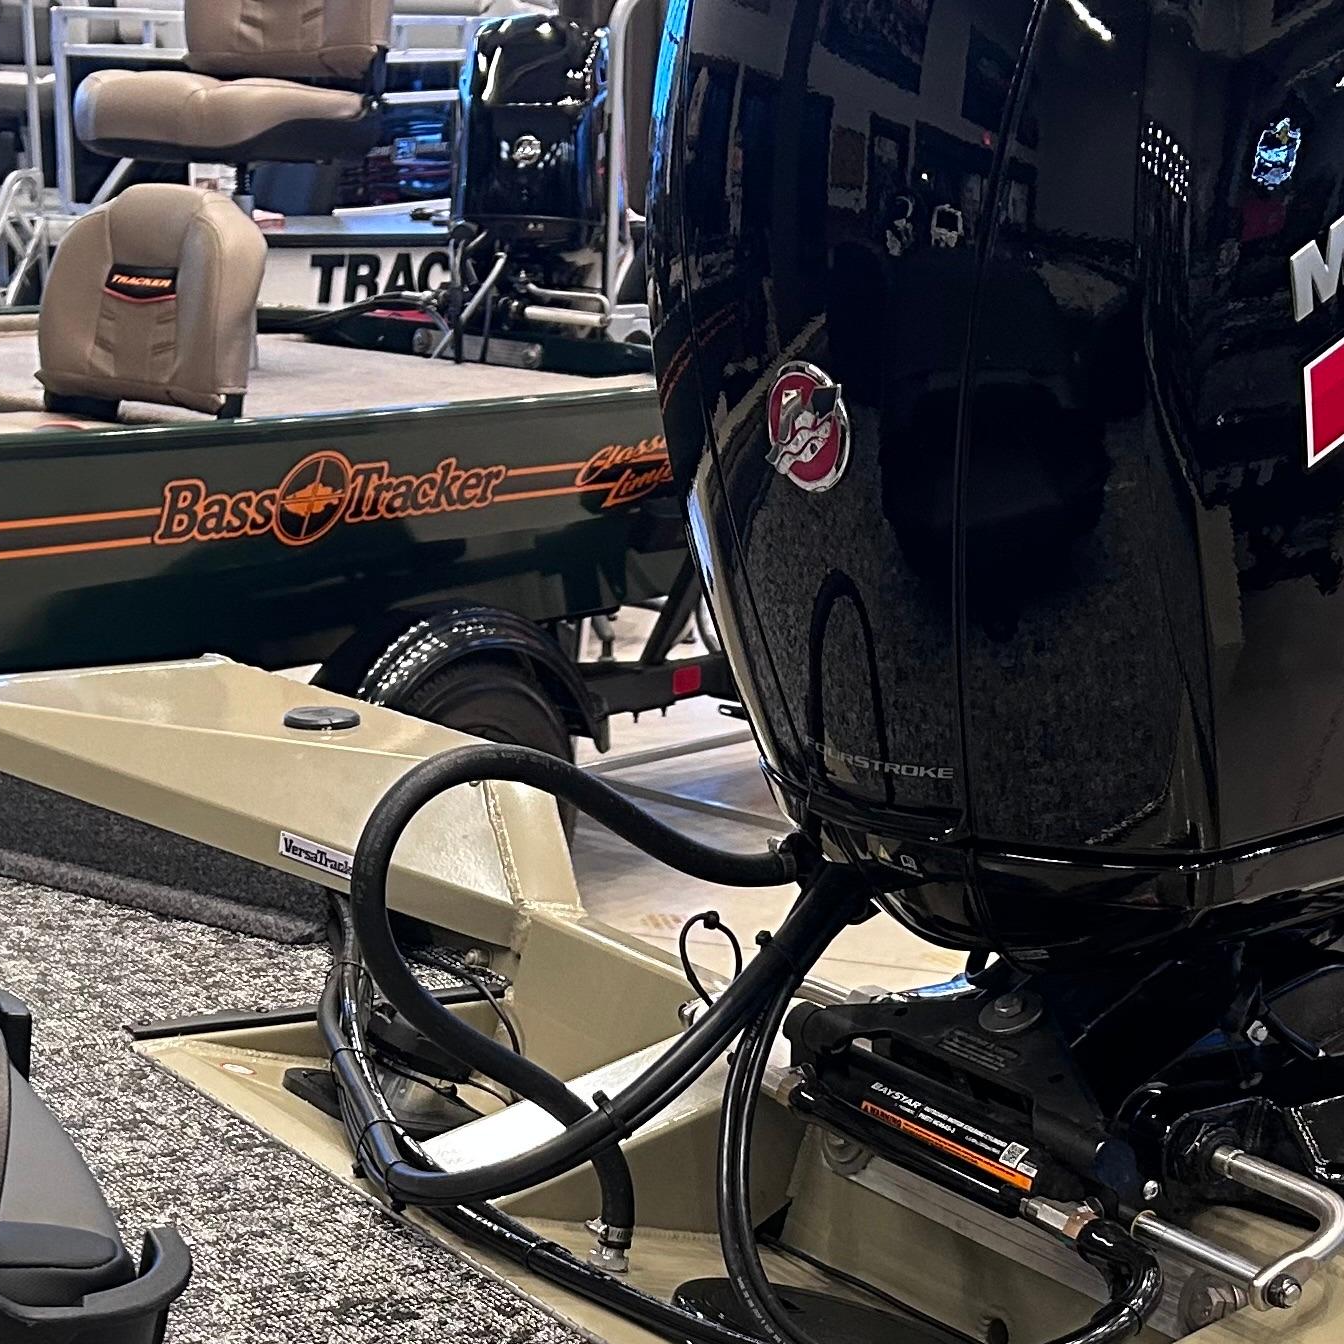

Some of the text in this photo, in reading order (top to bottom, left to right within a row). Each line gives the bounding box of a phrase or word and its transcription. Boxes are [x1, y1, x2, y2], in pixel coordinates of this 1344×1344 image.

[111, 273, 174, 289] TRACKER
[310, 251, 451, 304] TRAC
[154, 456, 508, 545] Bass Tracker
[805, 735, 955, 780] FOURSTROKE
[870, 1081, 923, 1110] BAYSTAR
